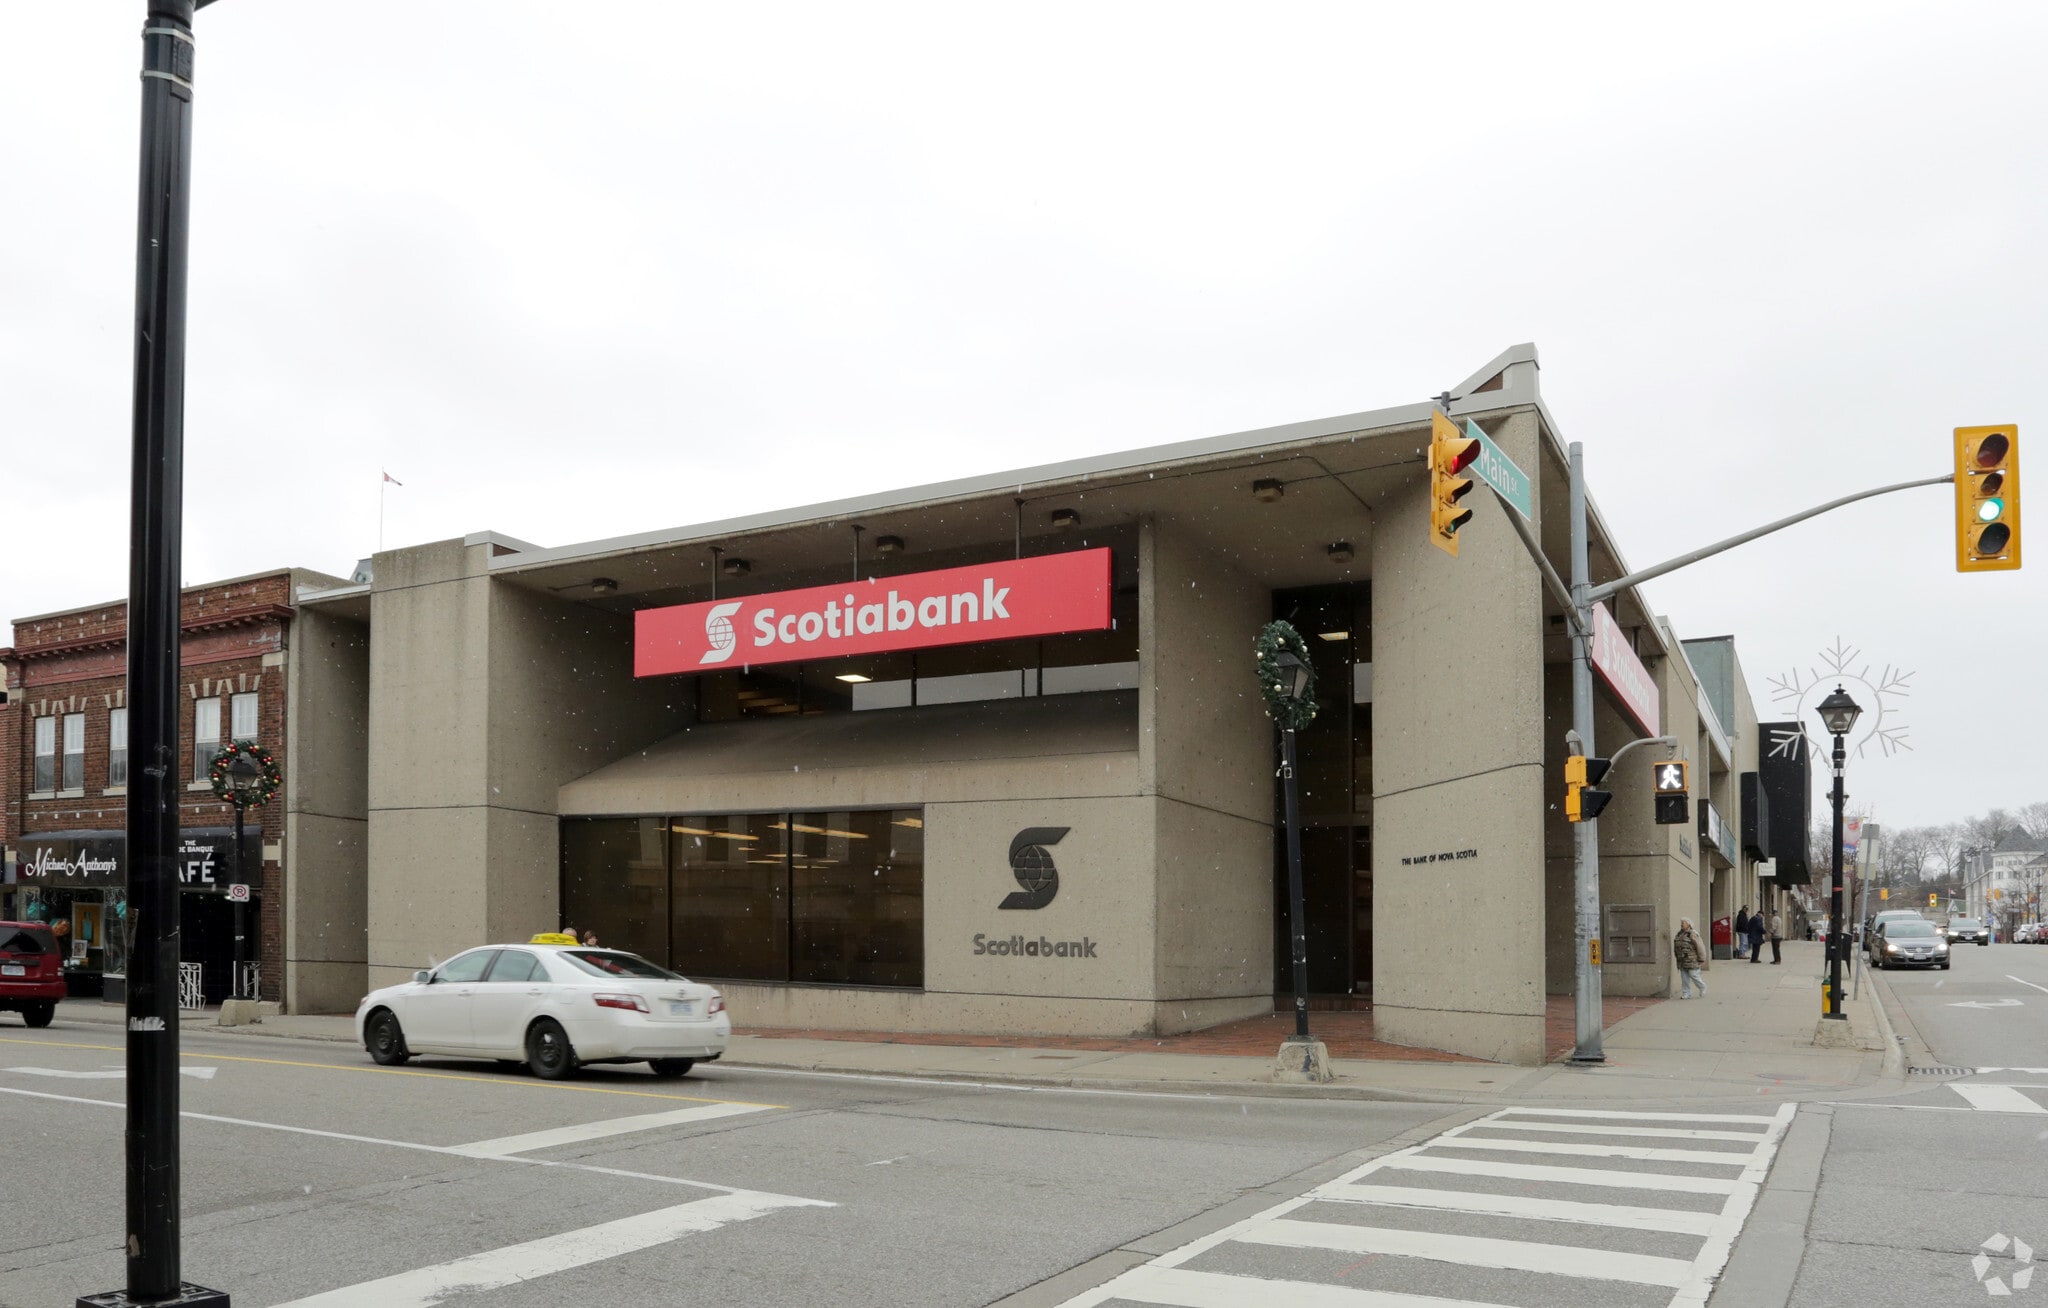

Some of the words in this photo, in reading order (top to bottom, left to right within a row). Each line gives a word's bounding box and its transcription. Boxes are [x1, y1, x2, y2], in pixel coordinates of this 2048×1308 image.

[1480, 442, 1510, 494] Main
[753, 577, 1012, 648] Scotiabank
[25, 847, 67, 877] Michael
[65, 848, 117, 878] Anthony's
[1402, 858, 1411, 866] THE
[1413, 856, 1427, 864] BANK
[1429, 854, 1436, 863] OF
[1438, 852, 1454, 861] NOVA
[1456, 849, 1478, 859] SCOTIA
[973, 933, 1097, 958] Scotiabank
